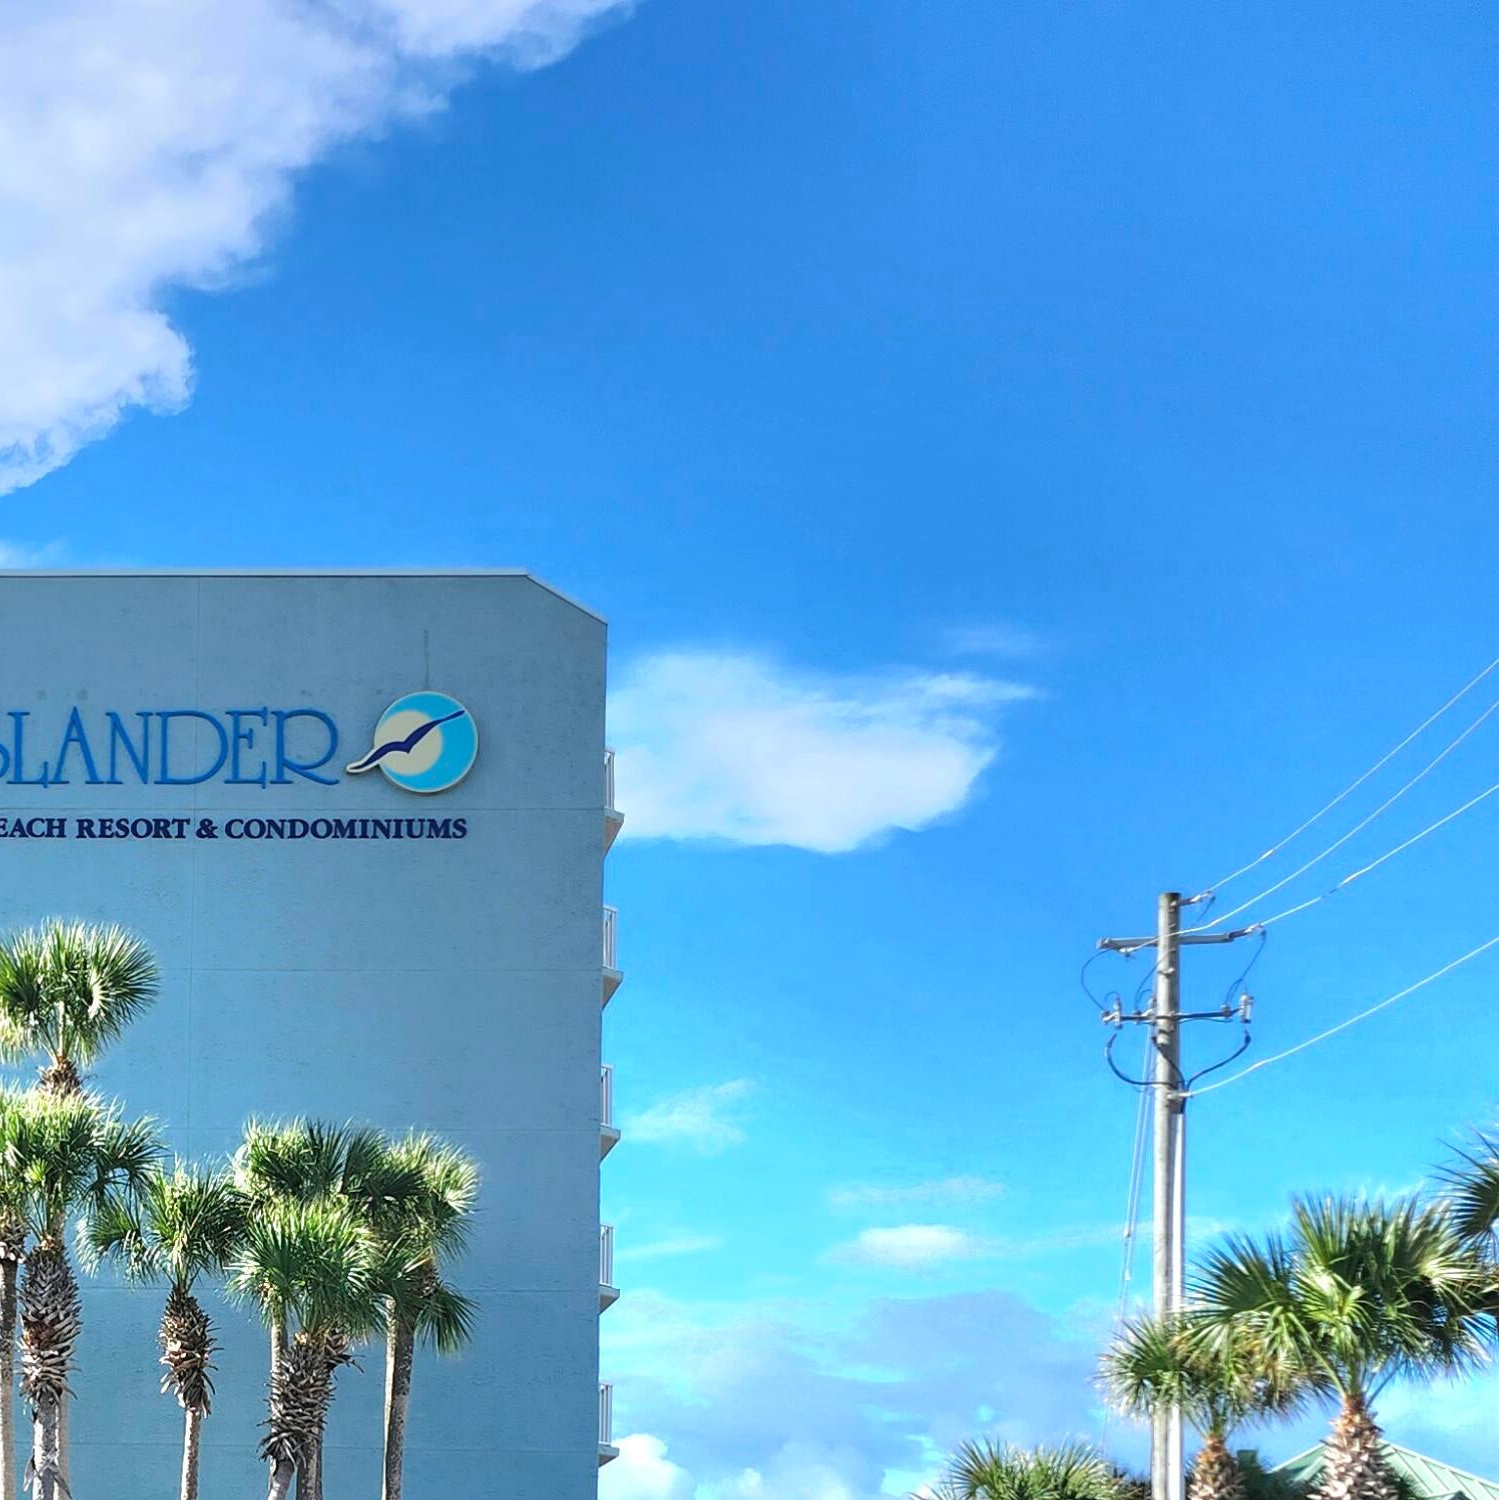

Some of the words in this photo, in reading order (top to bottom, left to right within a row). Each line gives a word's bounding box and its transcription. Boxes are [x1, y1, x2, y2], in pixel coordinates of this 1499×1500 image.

[75, 817, 191, 839] RESORT
[195, 817, 219, 839] &
[224, 817, 467, 839] CONDOMINIUMS
